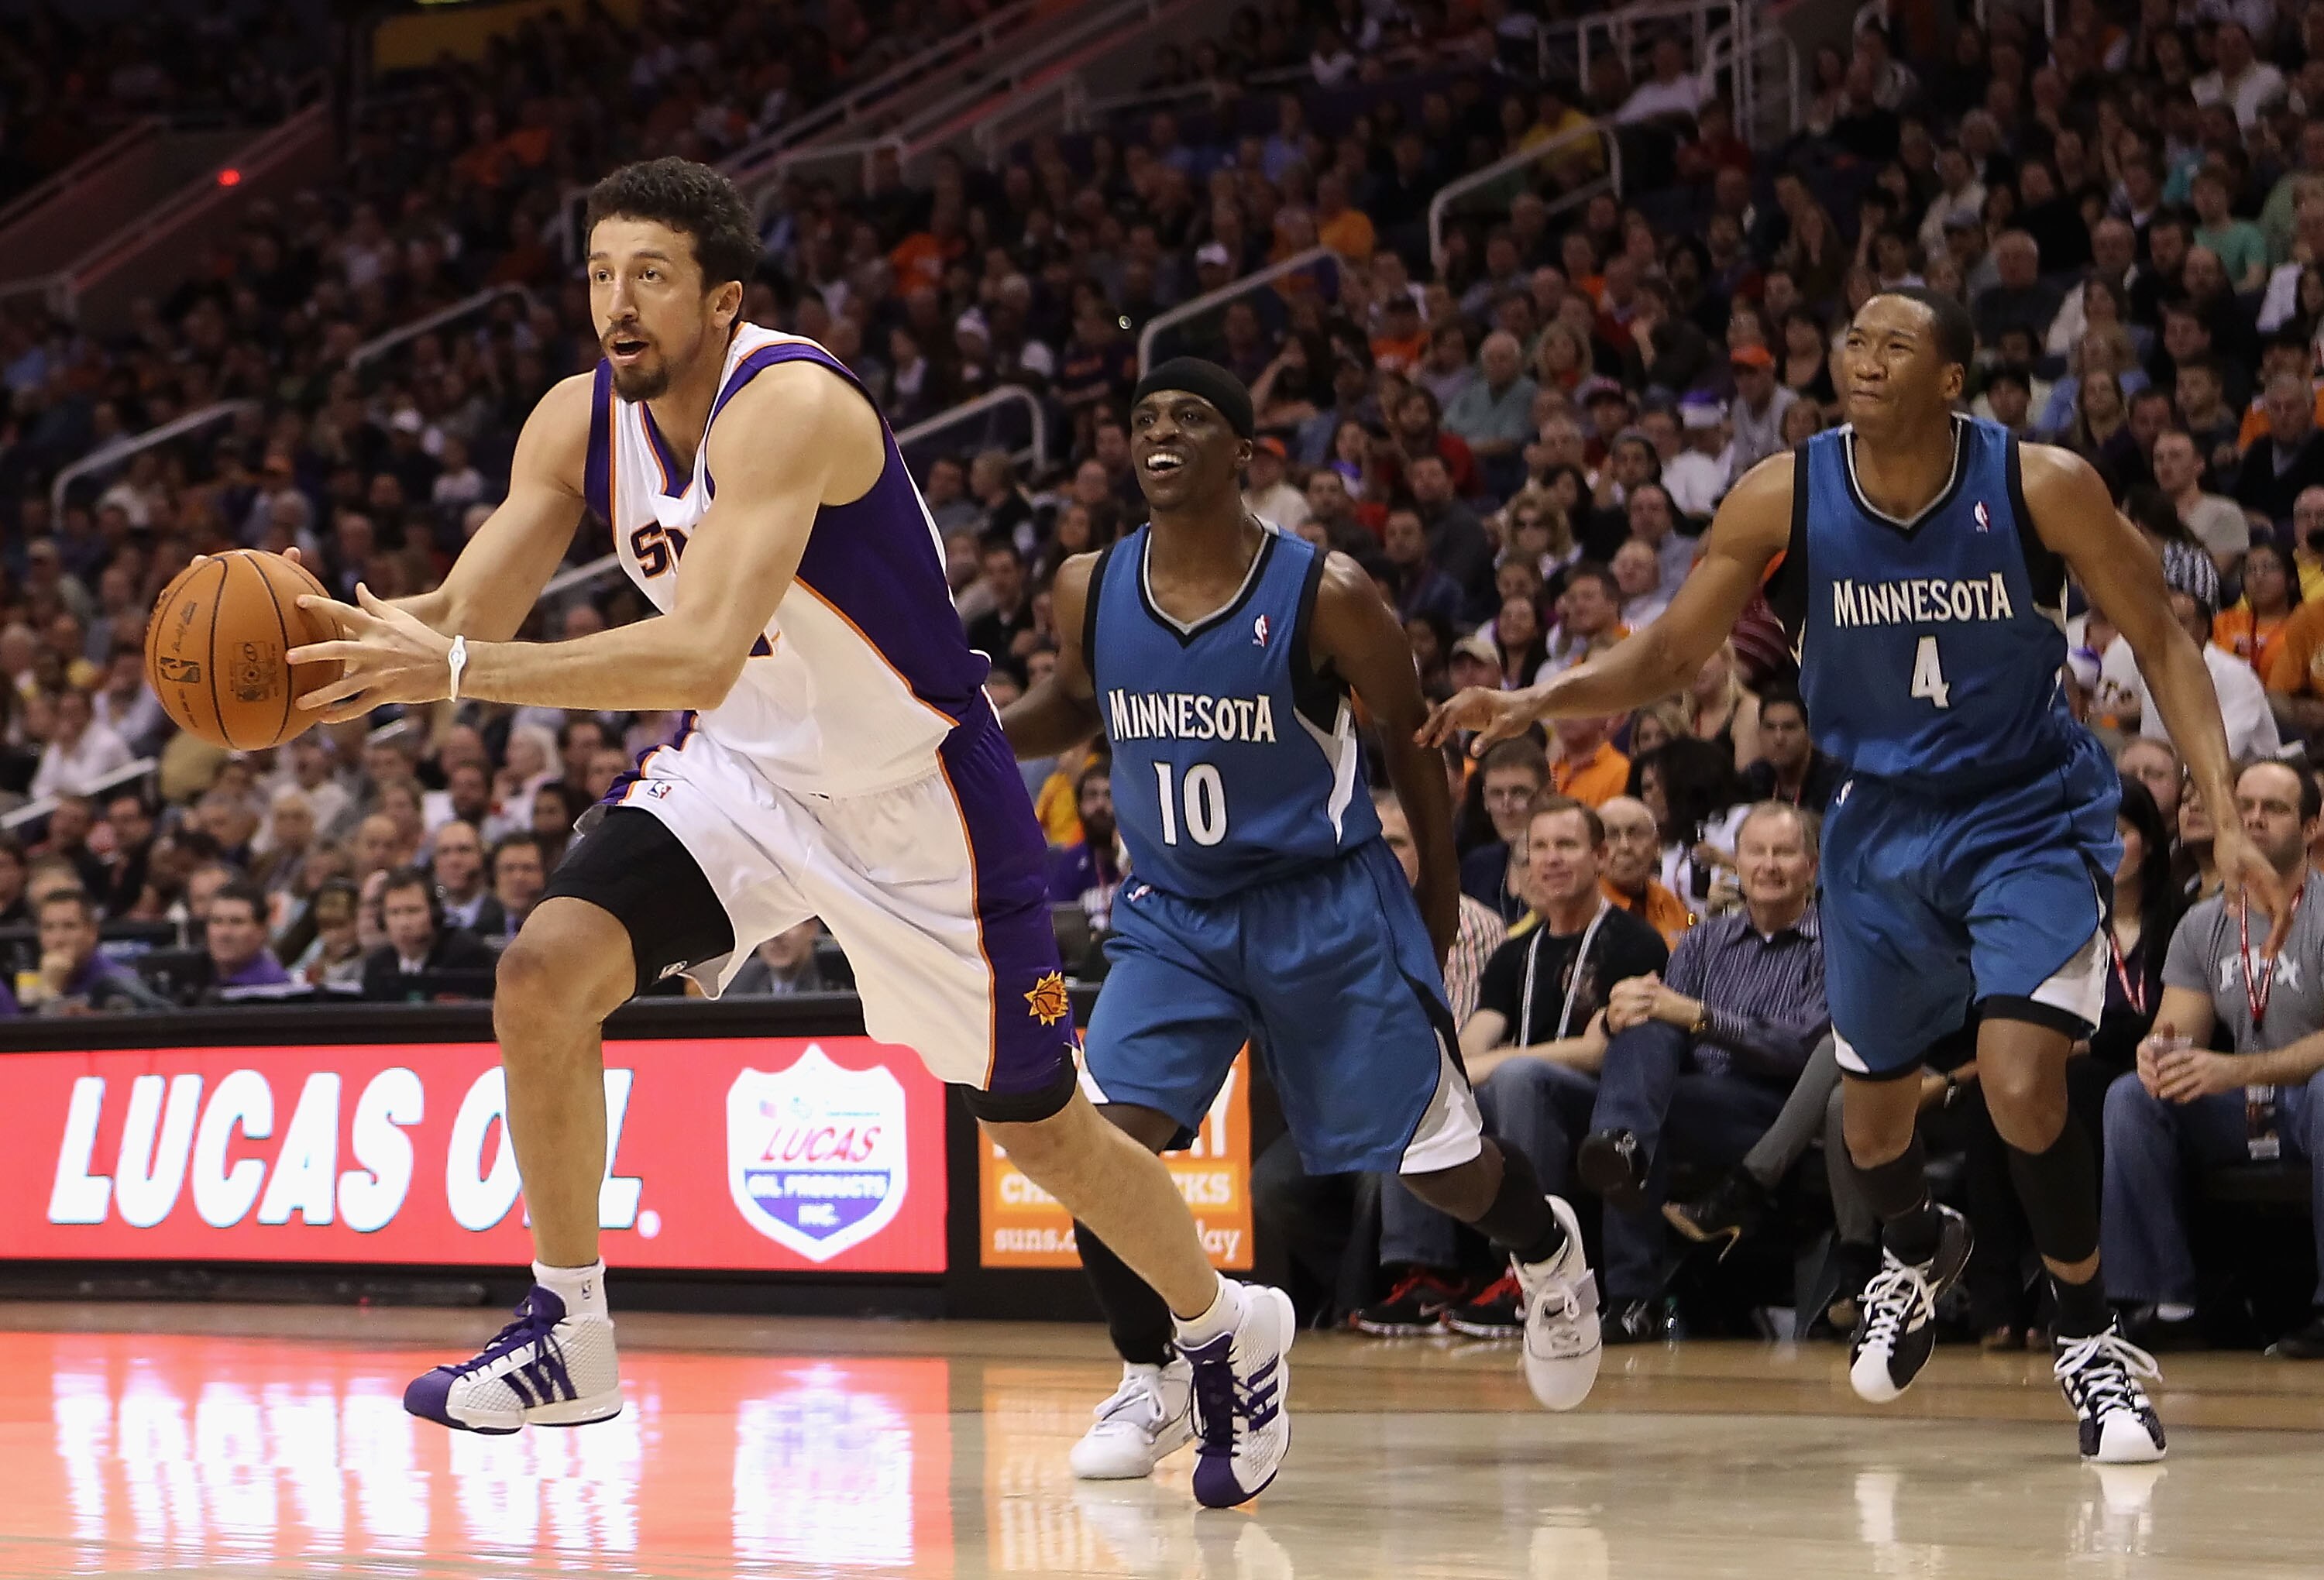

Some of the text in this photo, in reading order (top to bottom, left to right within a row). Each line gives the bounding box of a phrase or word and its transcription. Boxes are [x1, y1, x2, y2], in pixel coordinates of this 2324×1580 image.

[1833, 572, 2013, 629] MINNESOTA
[1911, 636, 1949, 708] 4
[1108, 689, 1277, 743] MINNESOTA
[1154, 761, 1227, 846] 10
[48, 1068, 424, 1232] LUCAS
[758, 1126, 881, 1162] LUCAS
